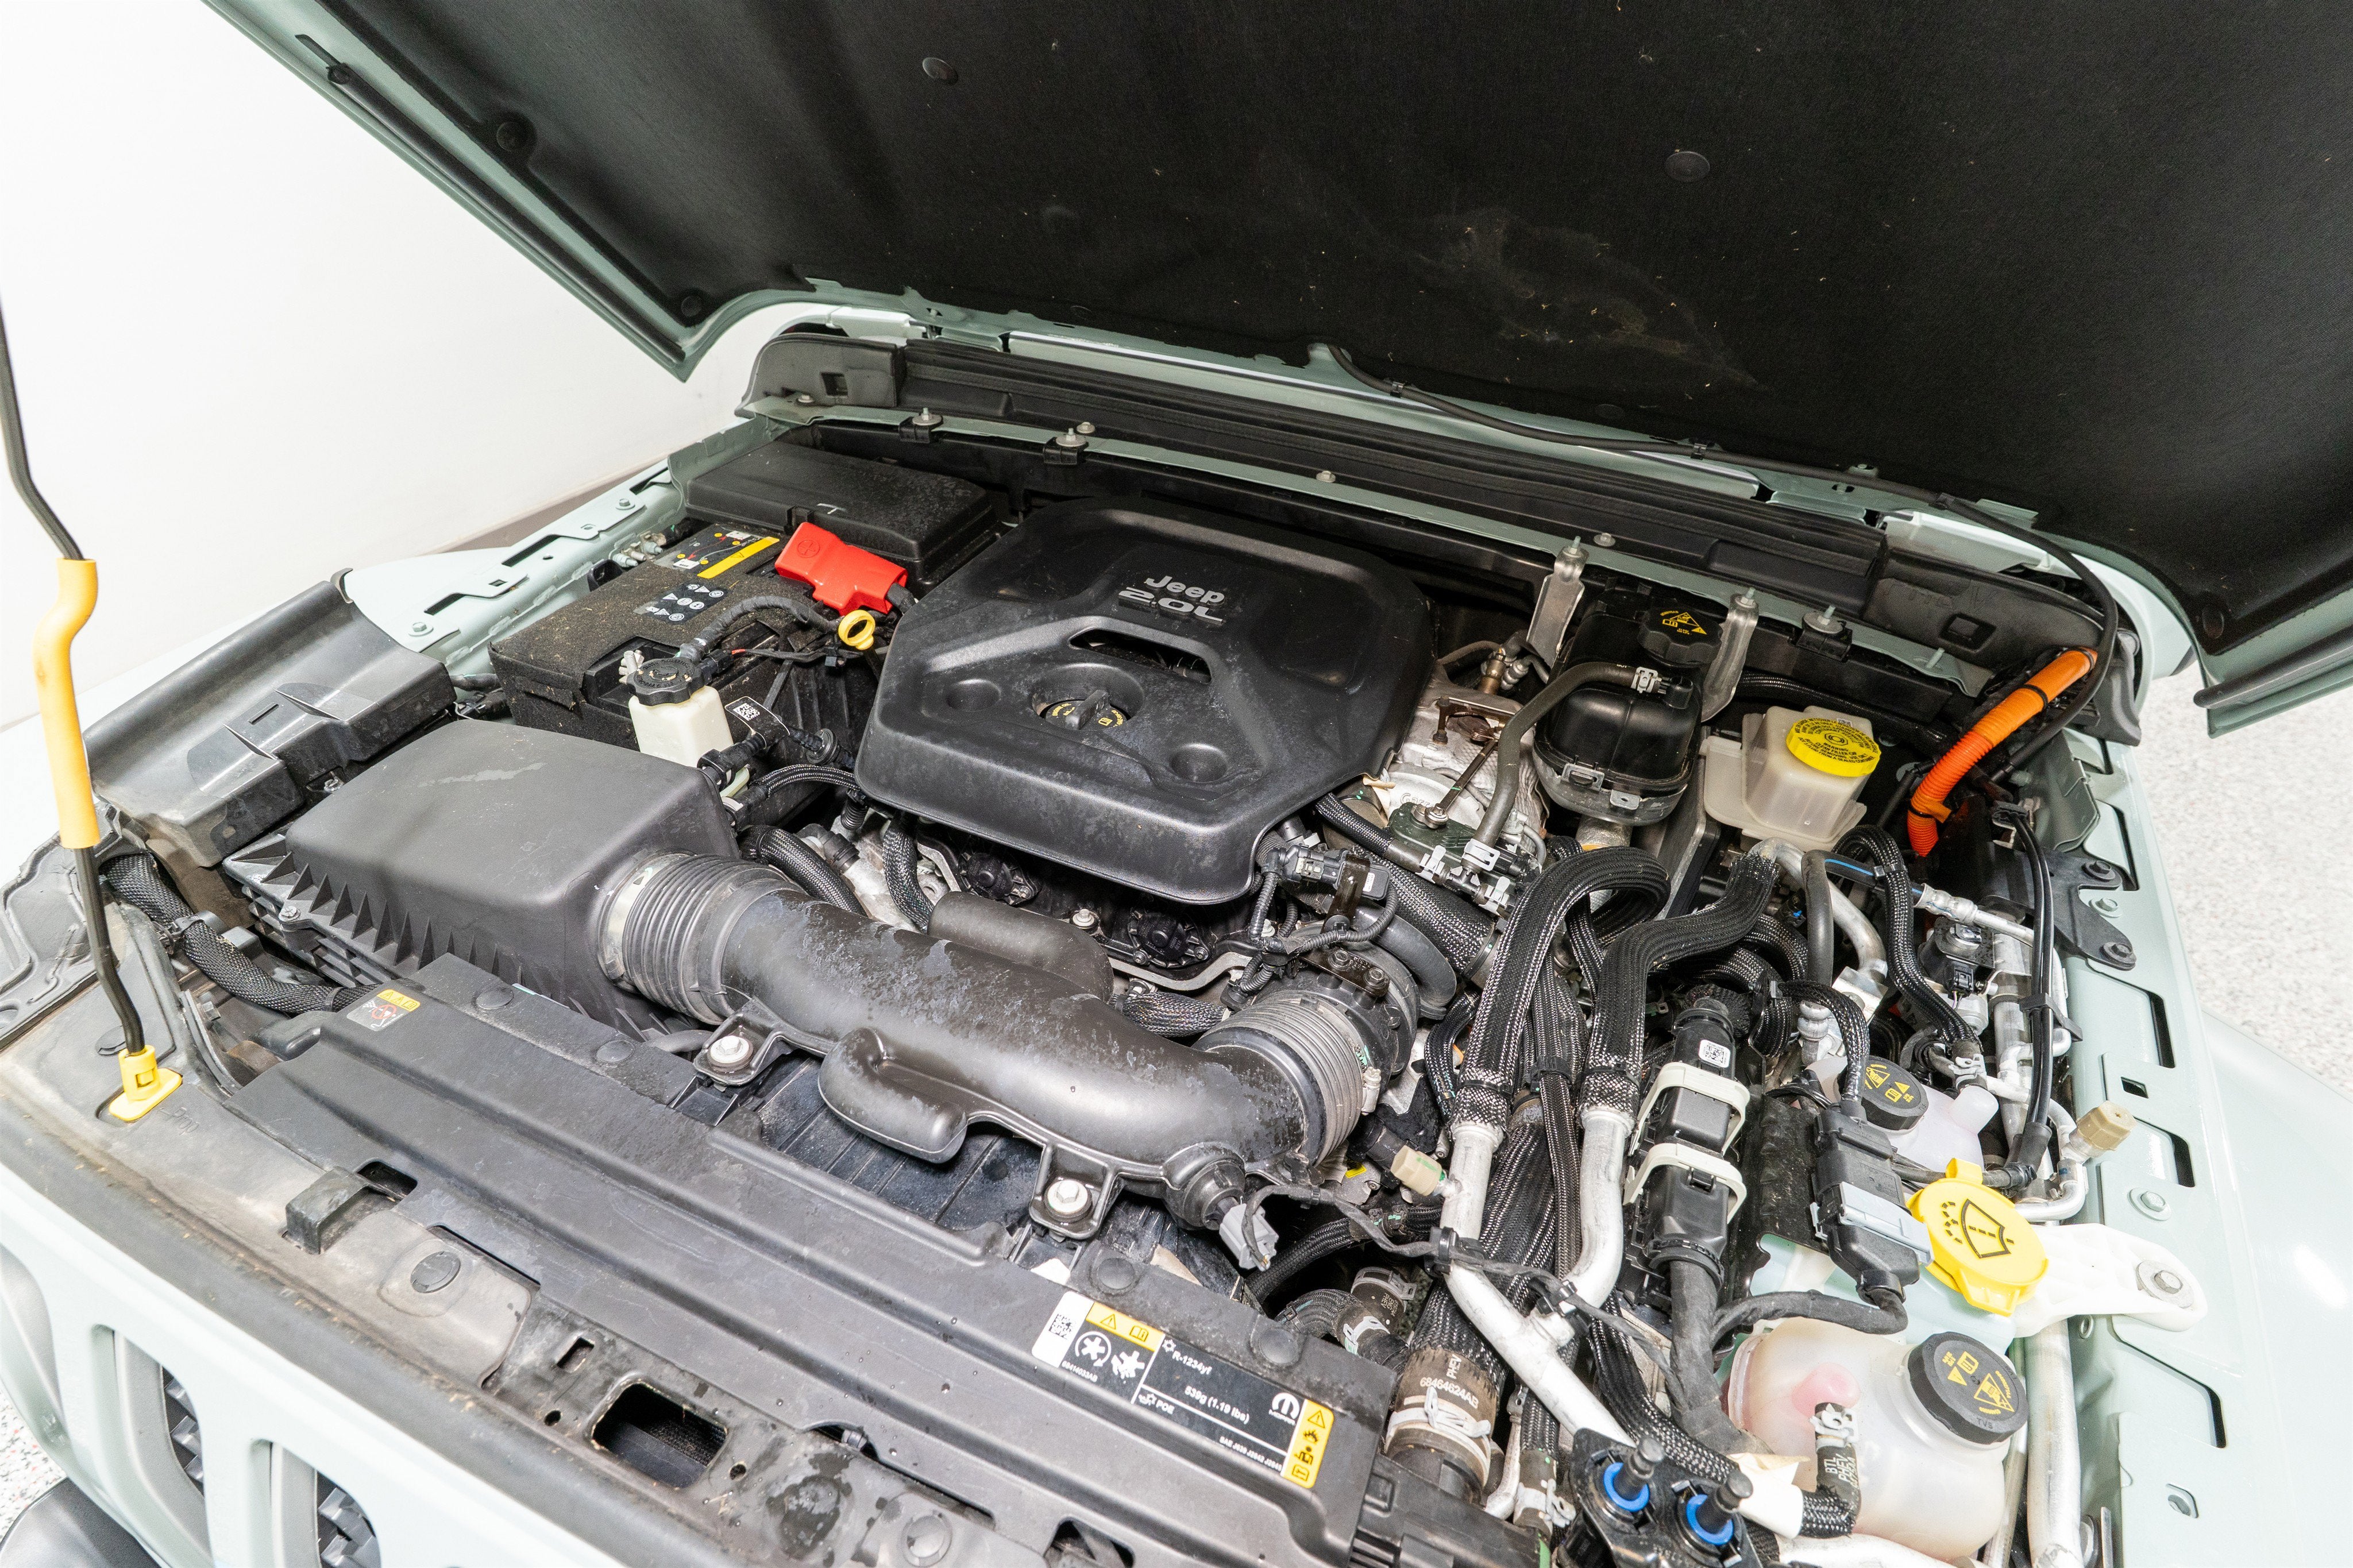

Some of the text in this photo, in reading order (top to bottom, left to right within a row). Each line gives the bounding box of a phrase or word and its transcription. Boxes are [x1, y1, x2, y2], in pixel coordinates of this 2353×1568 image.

[1145, 576, 1225, 604] Jeep
[1118, 586, 1224, 623] 2.0L
[164, 1106, 200, 1136] Prop
[1380, 1292, 1390, 1309] PHEV
[1387, 1297, 1395, 1310] ENG
[1172, 1350, 1212, 1374] R-1234yf
[1446, 1353, 1462, 1380] PHEV
[1156, 1399, 1175, 1415] POE
[1977, 1417, 1993, 1429] TVS
[1824, 1457, 1838, 1474] BTL
[1835, 1453, 1851, 1483] PHEV
